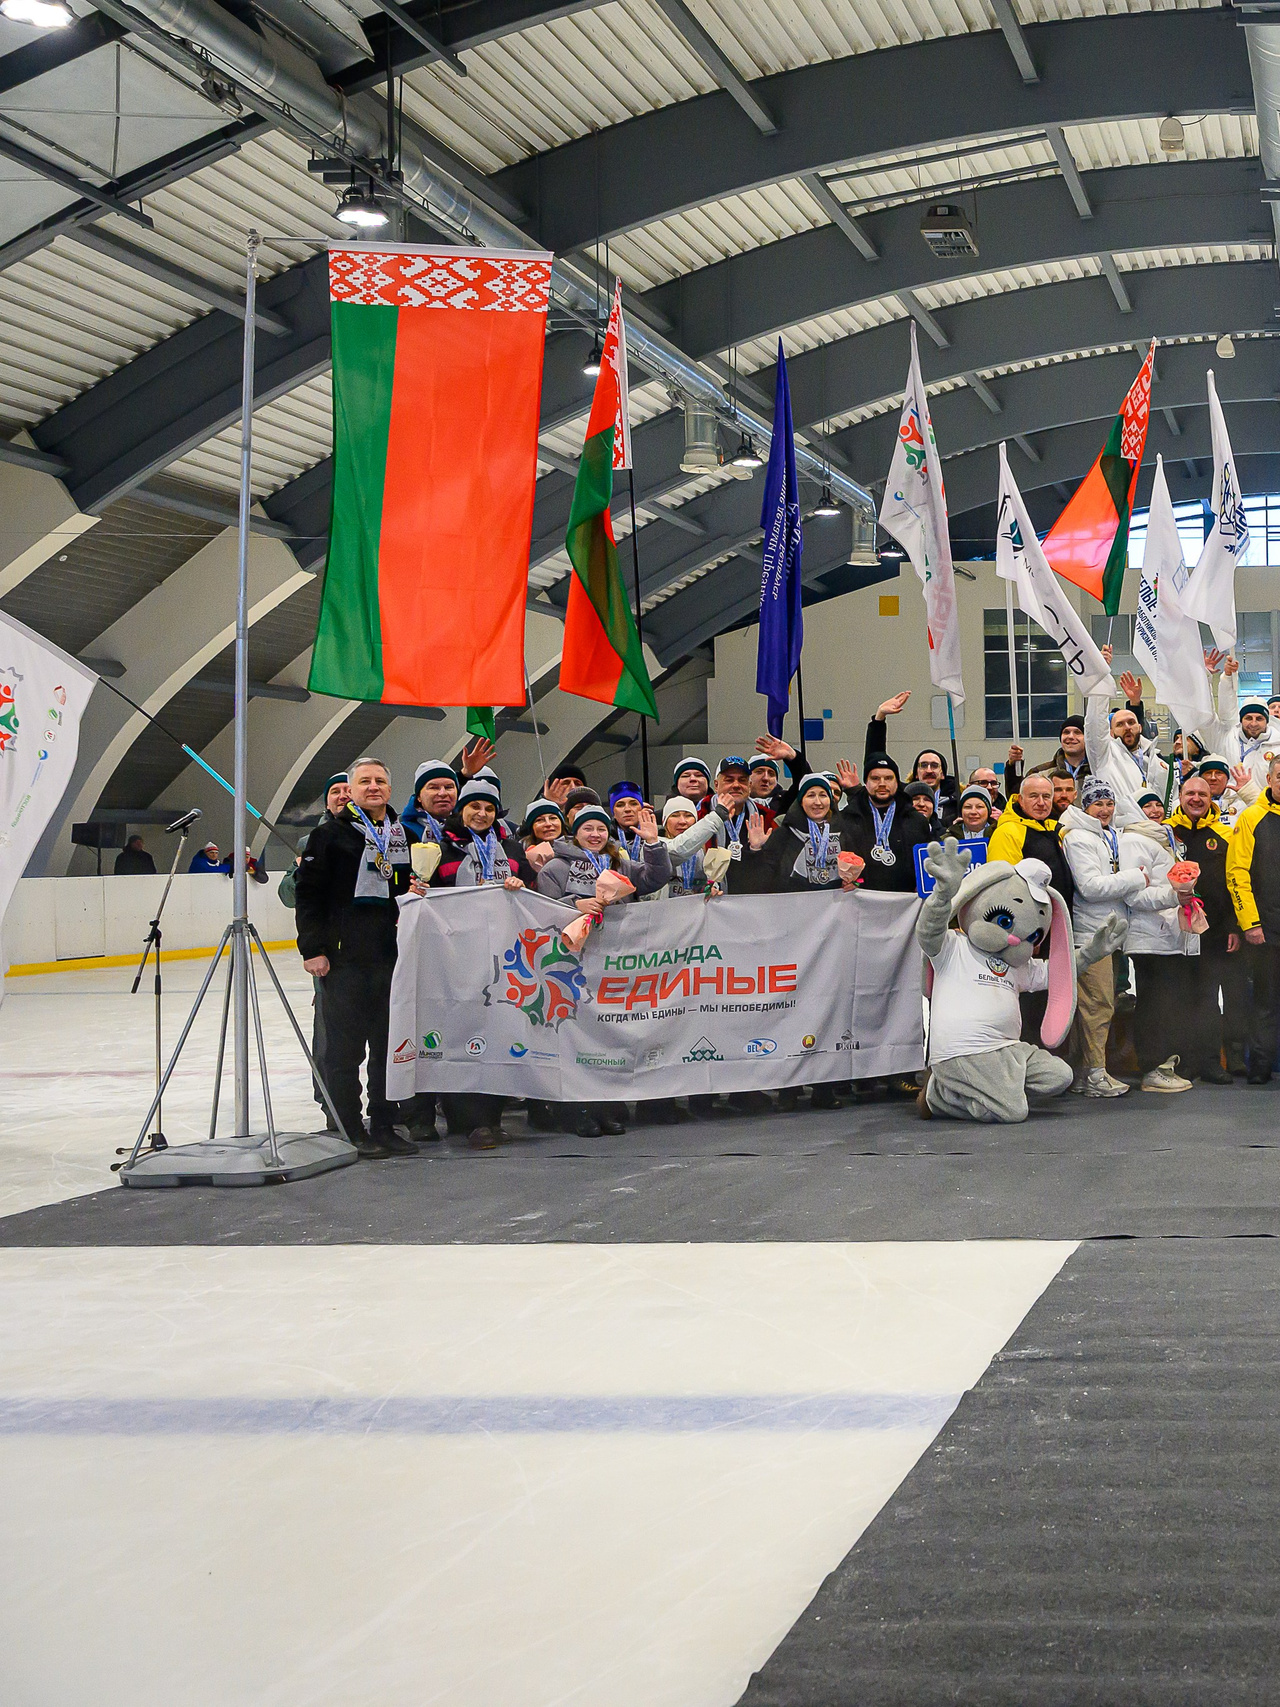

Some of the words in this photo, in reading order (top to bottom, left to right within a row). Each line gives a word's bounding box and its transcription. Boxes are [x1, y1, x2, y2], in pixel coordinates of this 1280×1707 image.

[604, 945, 723, 971] КОМАНДА
[597, 963, 798, 1011] ЕДИНЫЕ
[597, 1012, 629, 1024] КОГДА
[631, 1010, 650, 1021] МЫ
[652, 1007, 686, 1020] ЕДИНЫ
[700, 1003, 719, 1013] МЫ
[721, 999, 797, 1013] НЕПОБЕДИМЫ!
[575, 1057, 626, 1066] ВОСТОЧНЫЙ
